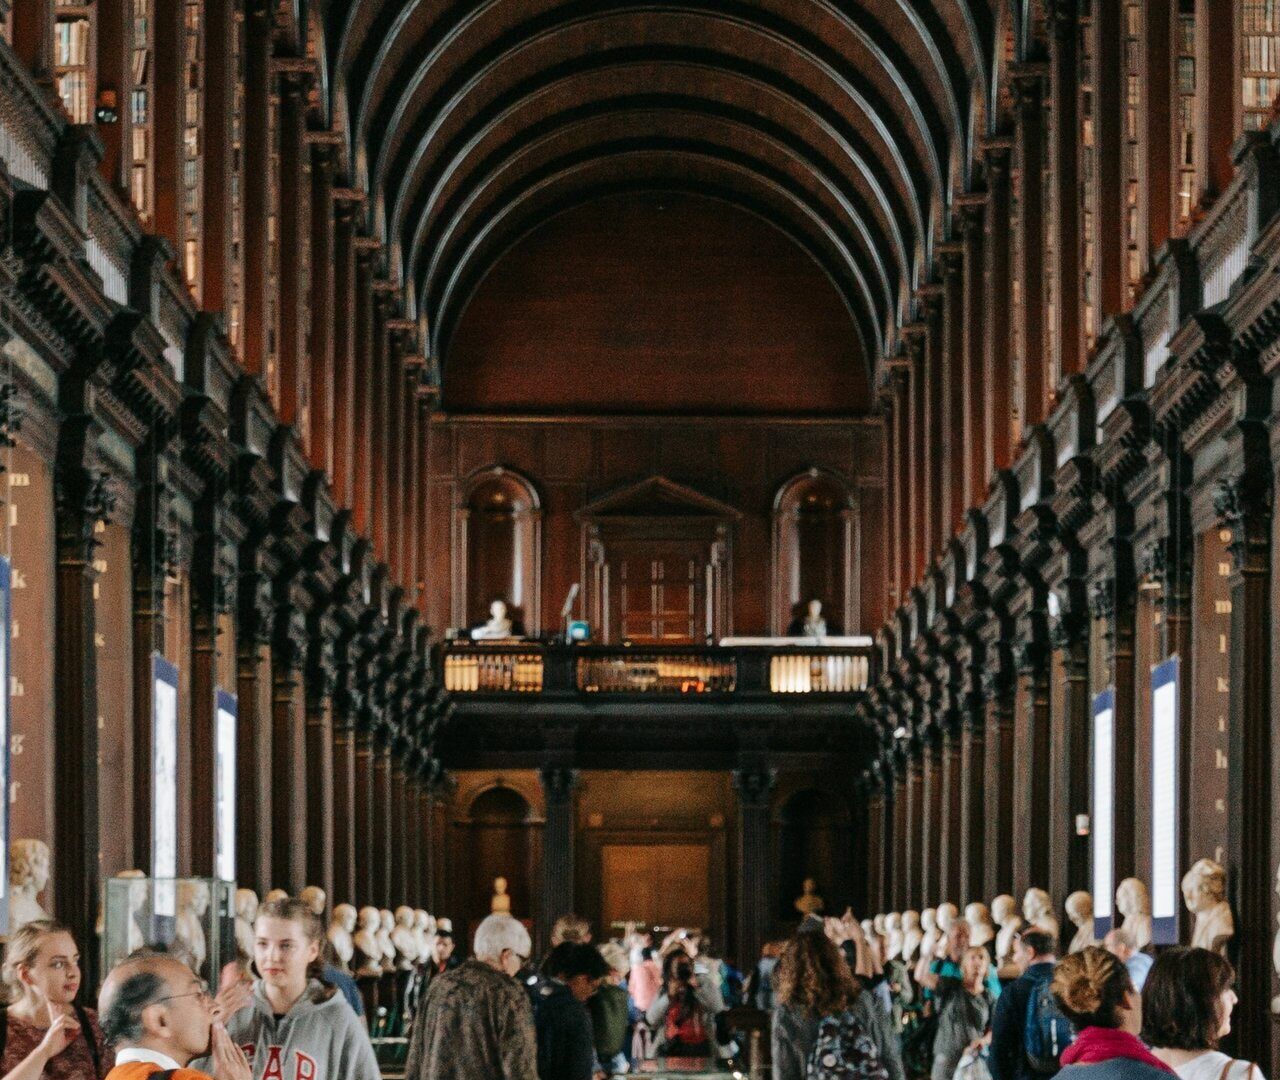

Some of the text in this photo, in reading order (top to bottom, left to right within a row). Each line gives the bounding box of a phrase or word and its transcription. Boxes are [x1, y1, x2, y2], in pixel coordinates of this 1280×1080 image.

[8, 473, 29, 487] m
[9, 505, 17, 526] l
[12, 569, 26, 588] k
